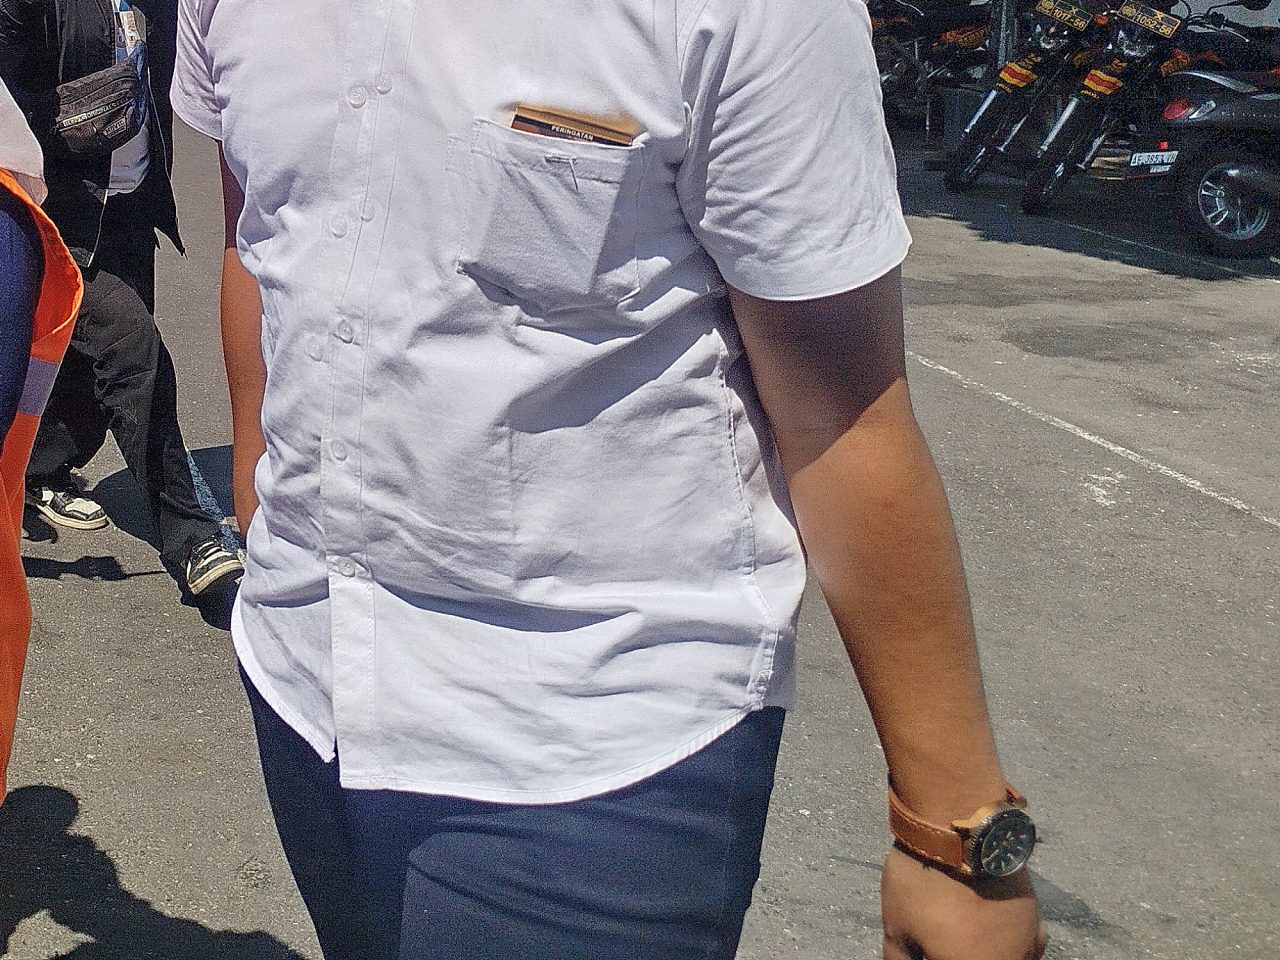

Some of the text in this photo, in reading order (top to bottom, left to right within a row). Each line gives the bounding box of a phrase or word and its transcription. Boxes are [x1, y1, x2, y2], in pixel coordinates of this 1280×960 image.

[1053, 8, 1086, 29] 1017-56
[1136, 14, 1173, 36] 1052-56
[551, 125, 594, 141] PERINGATAN
